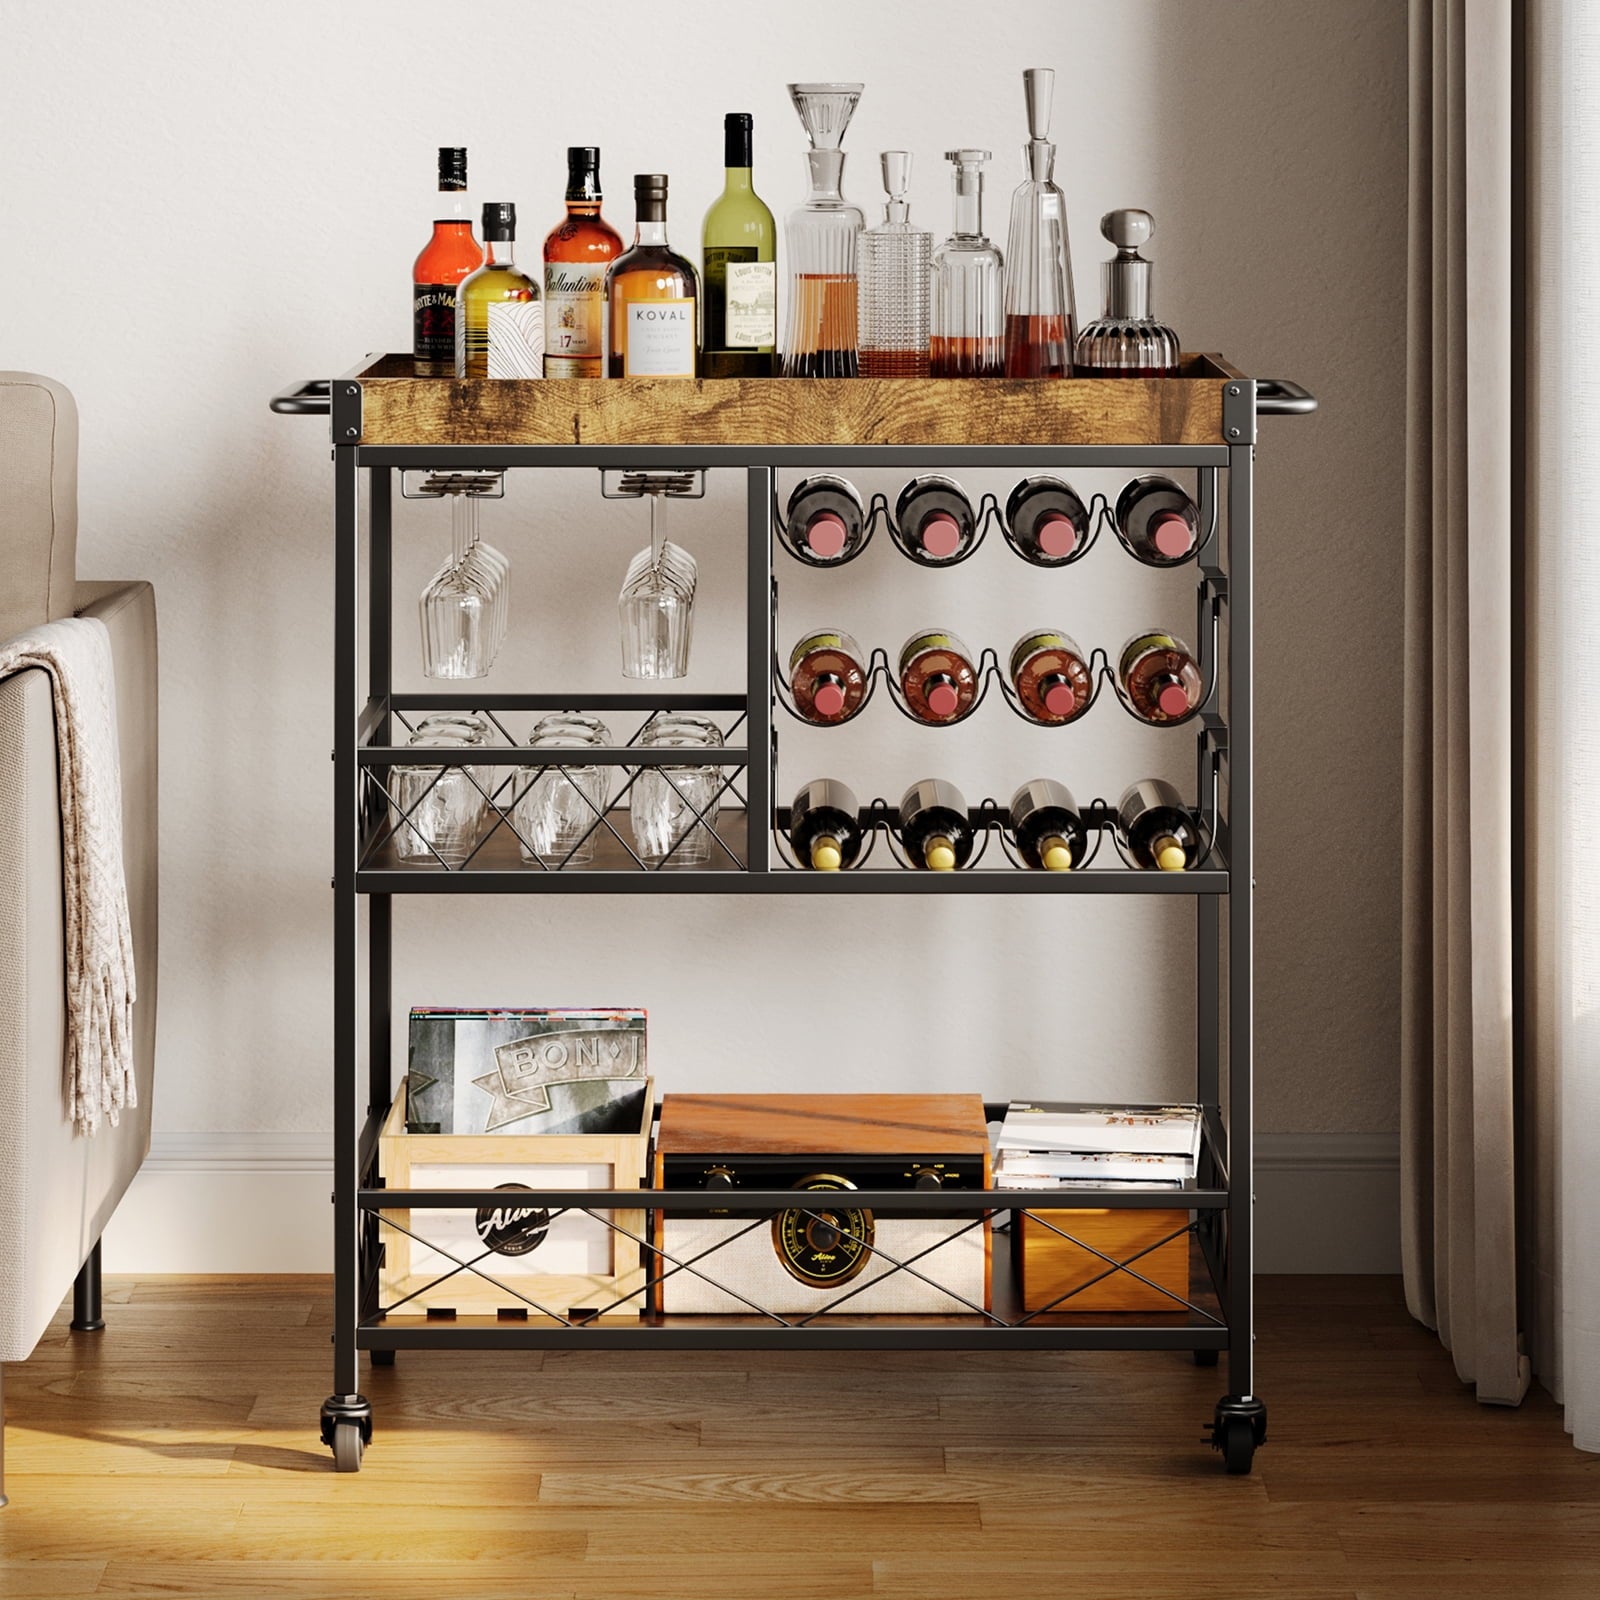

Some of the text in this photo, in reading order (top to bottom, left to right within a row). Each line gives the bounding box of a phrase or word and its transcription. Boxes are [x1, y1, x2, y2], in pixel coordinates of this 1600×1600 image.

[544, 267, 601, 292] Ballantine's
[636, 310, 686, 321] KOVAL
[559, 335, 572, 347] 17
[511, 1037, 600, 1079] BON
